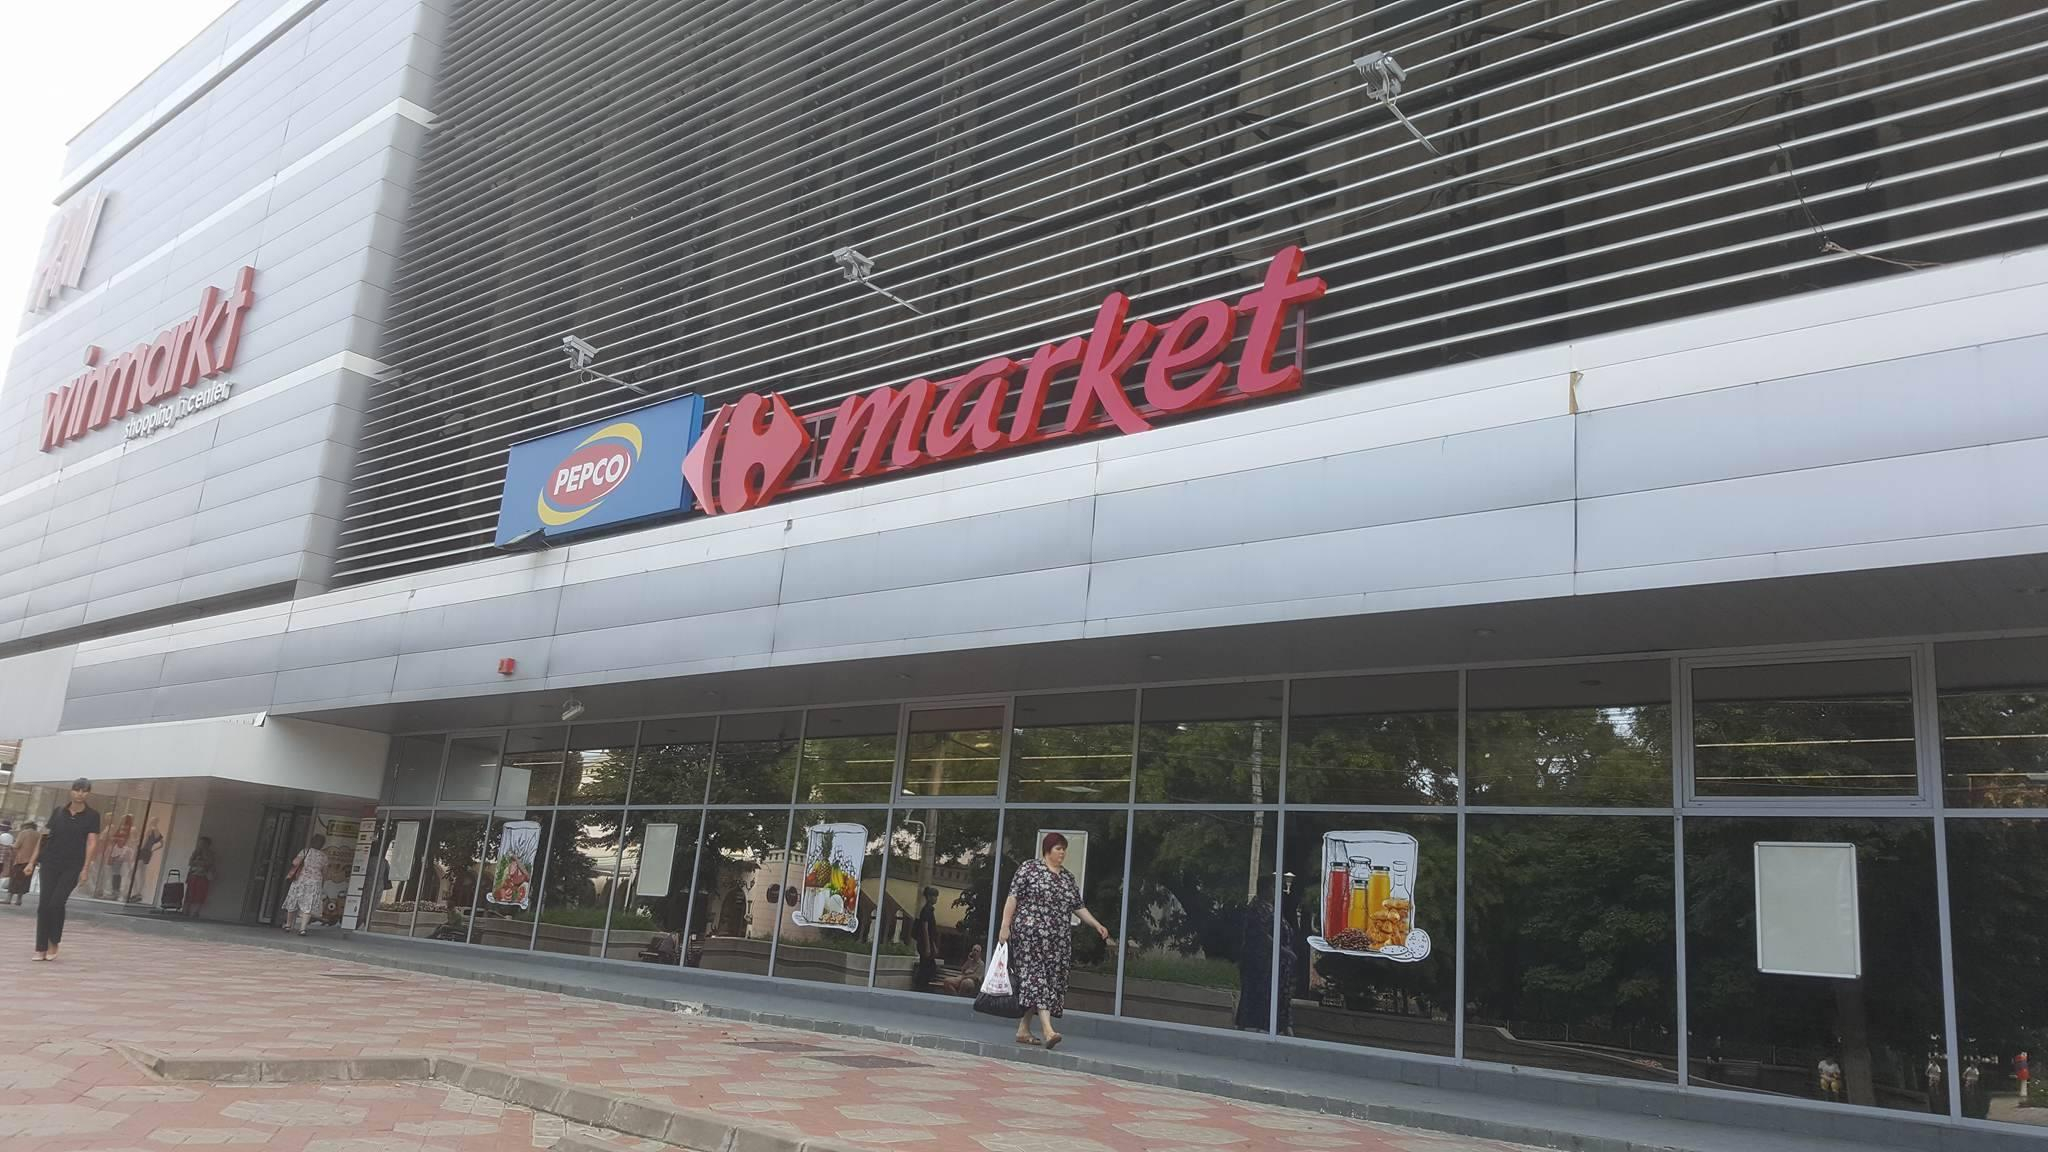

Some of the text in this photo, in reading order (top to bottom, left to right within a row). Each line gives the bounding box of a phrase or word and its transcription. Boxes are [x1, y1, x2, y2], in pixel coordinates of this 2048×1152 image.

[40, 265, 256, 453] winmarkt
[818, 246, 1327, 485] market
[125, 403, 175, 439] shopping
[553, 454, 625, 495] PEPCO
